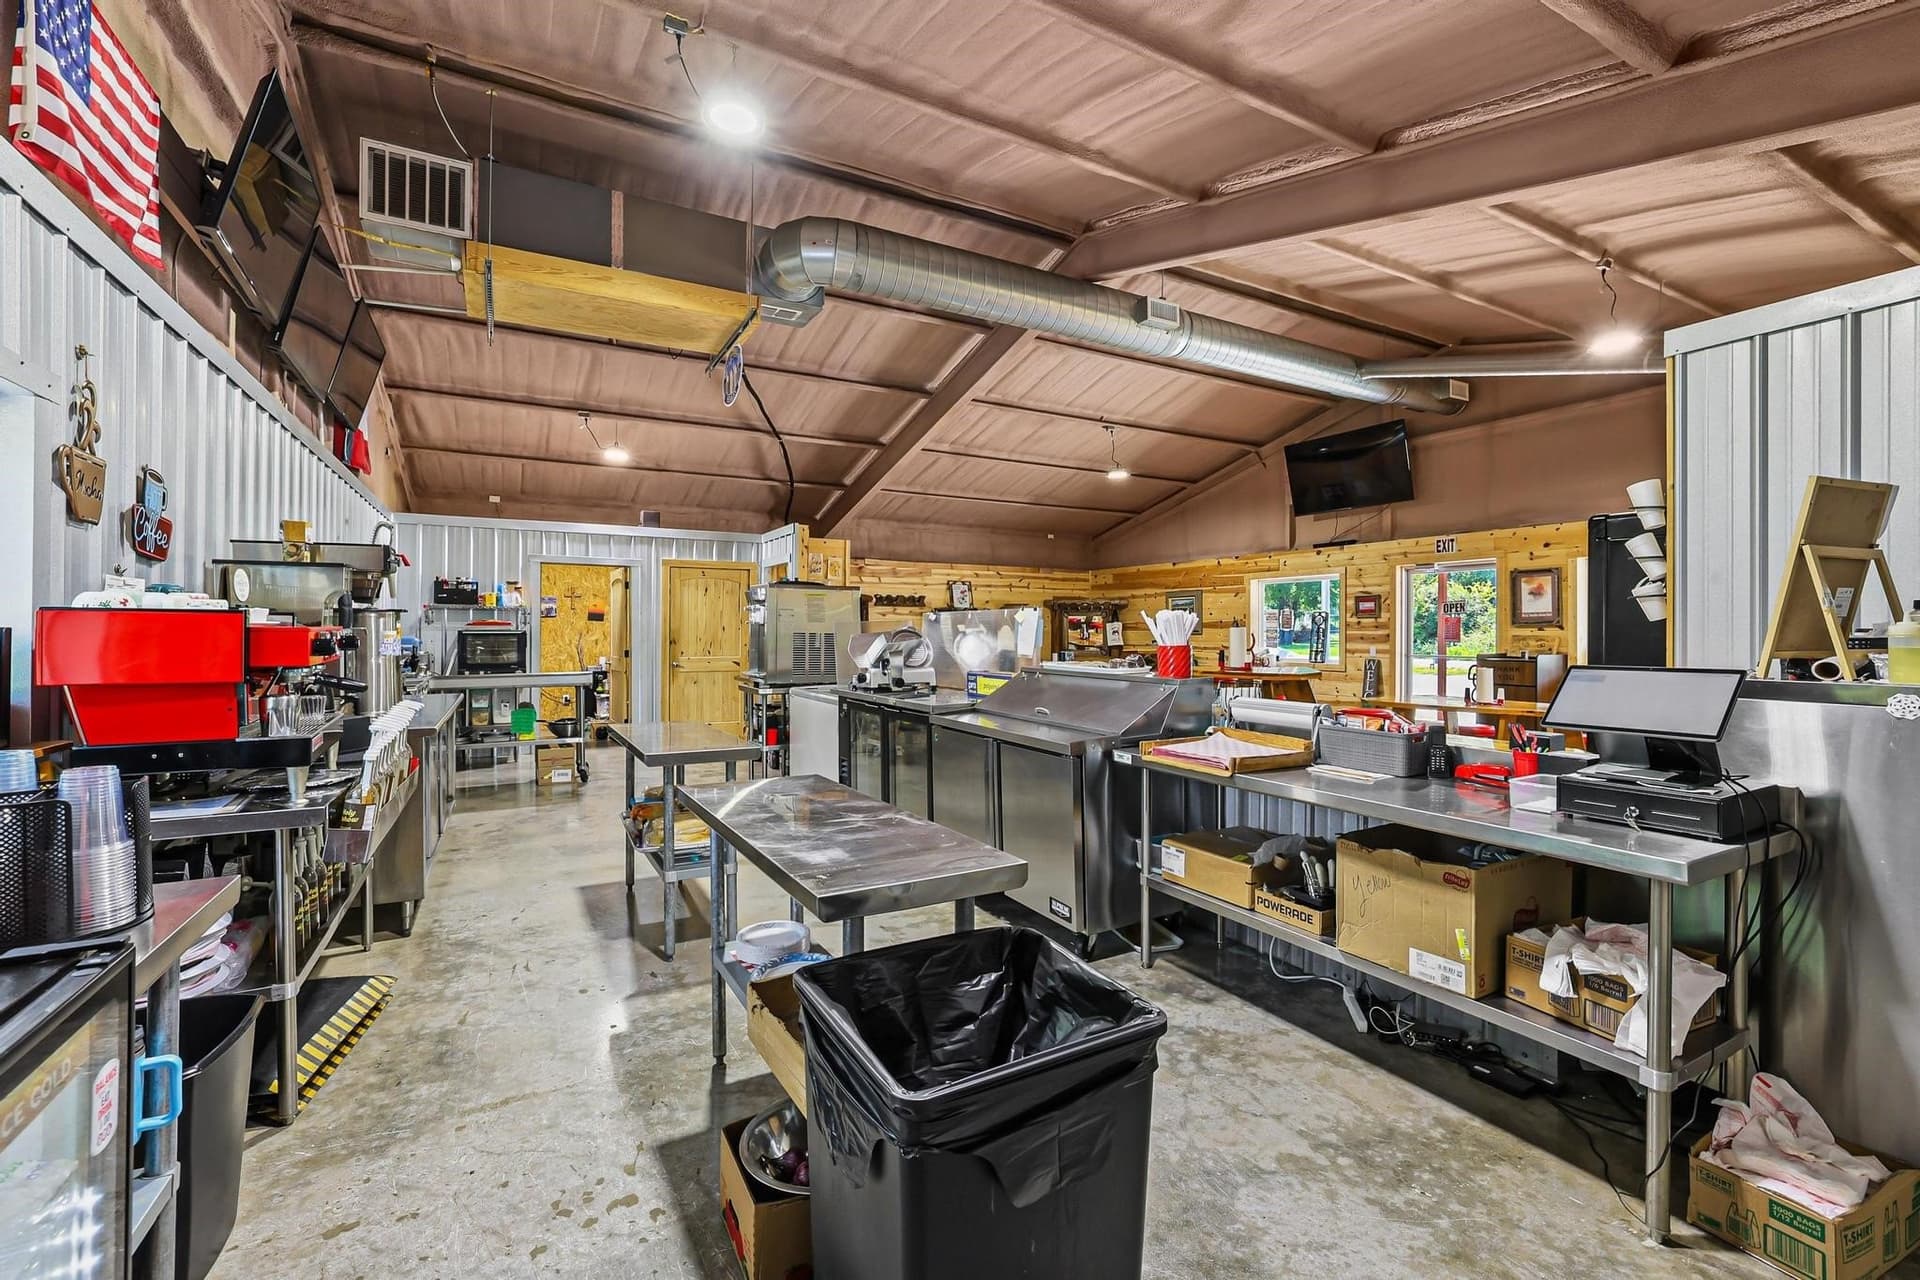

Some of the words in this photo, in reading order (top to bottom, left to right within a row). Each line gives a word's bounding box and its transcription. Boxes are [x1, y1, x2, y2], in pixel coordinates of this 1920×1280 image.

[134, 506, 169, 552] Coffee
[1436, 538, 1455, 553] EXIT
[1443, 602, 1466, 614] OPEN
[1257, 895, 1314, 925] POWERADE
[1, 1101, 25, 1137] CE
[31, 1058, 71, 1109] COLD
[1796, 1214, 1821, 1231] BAGS
[1842, 1223, 1874, 1246] T-SHIRT
